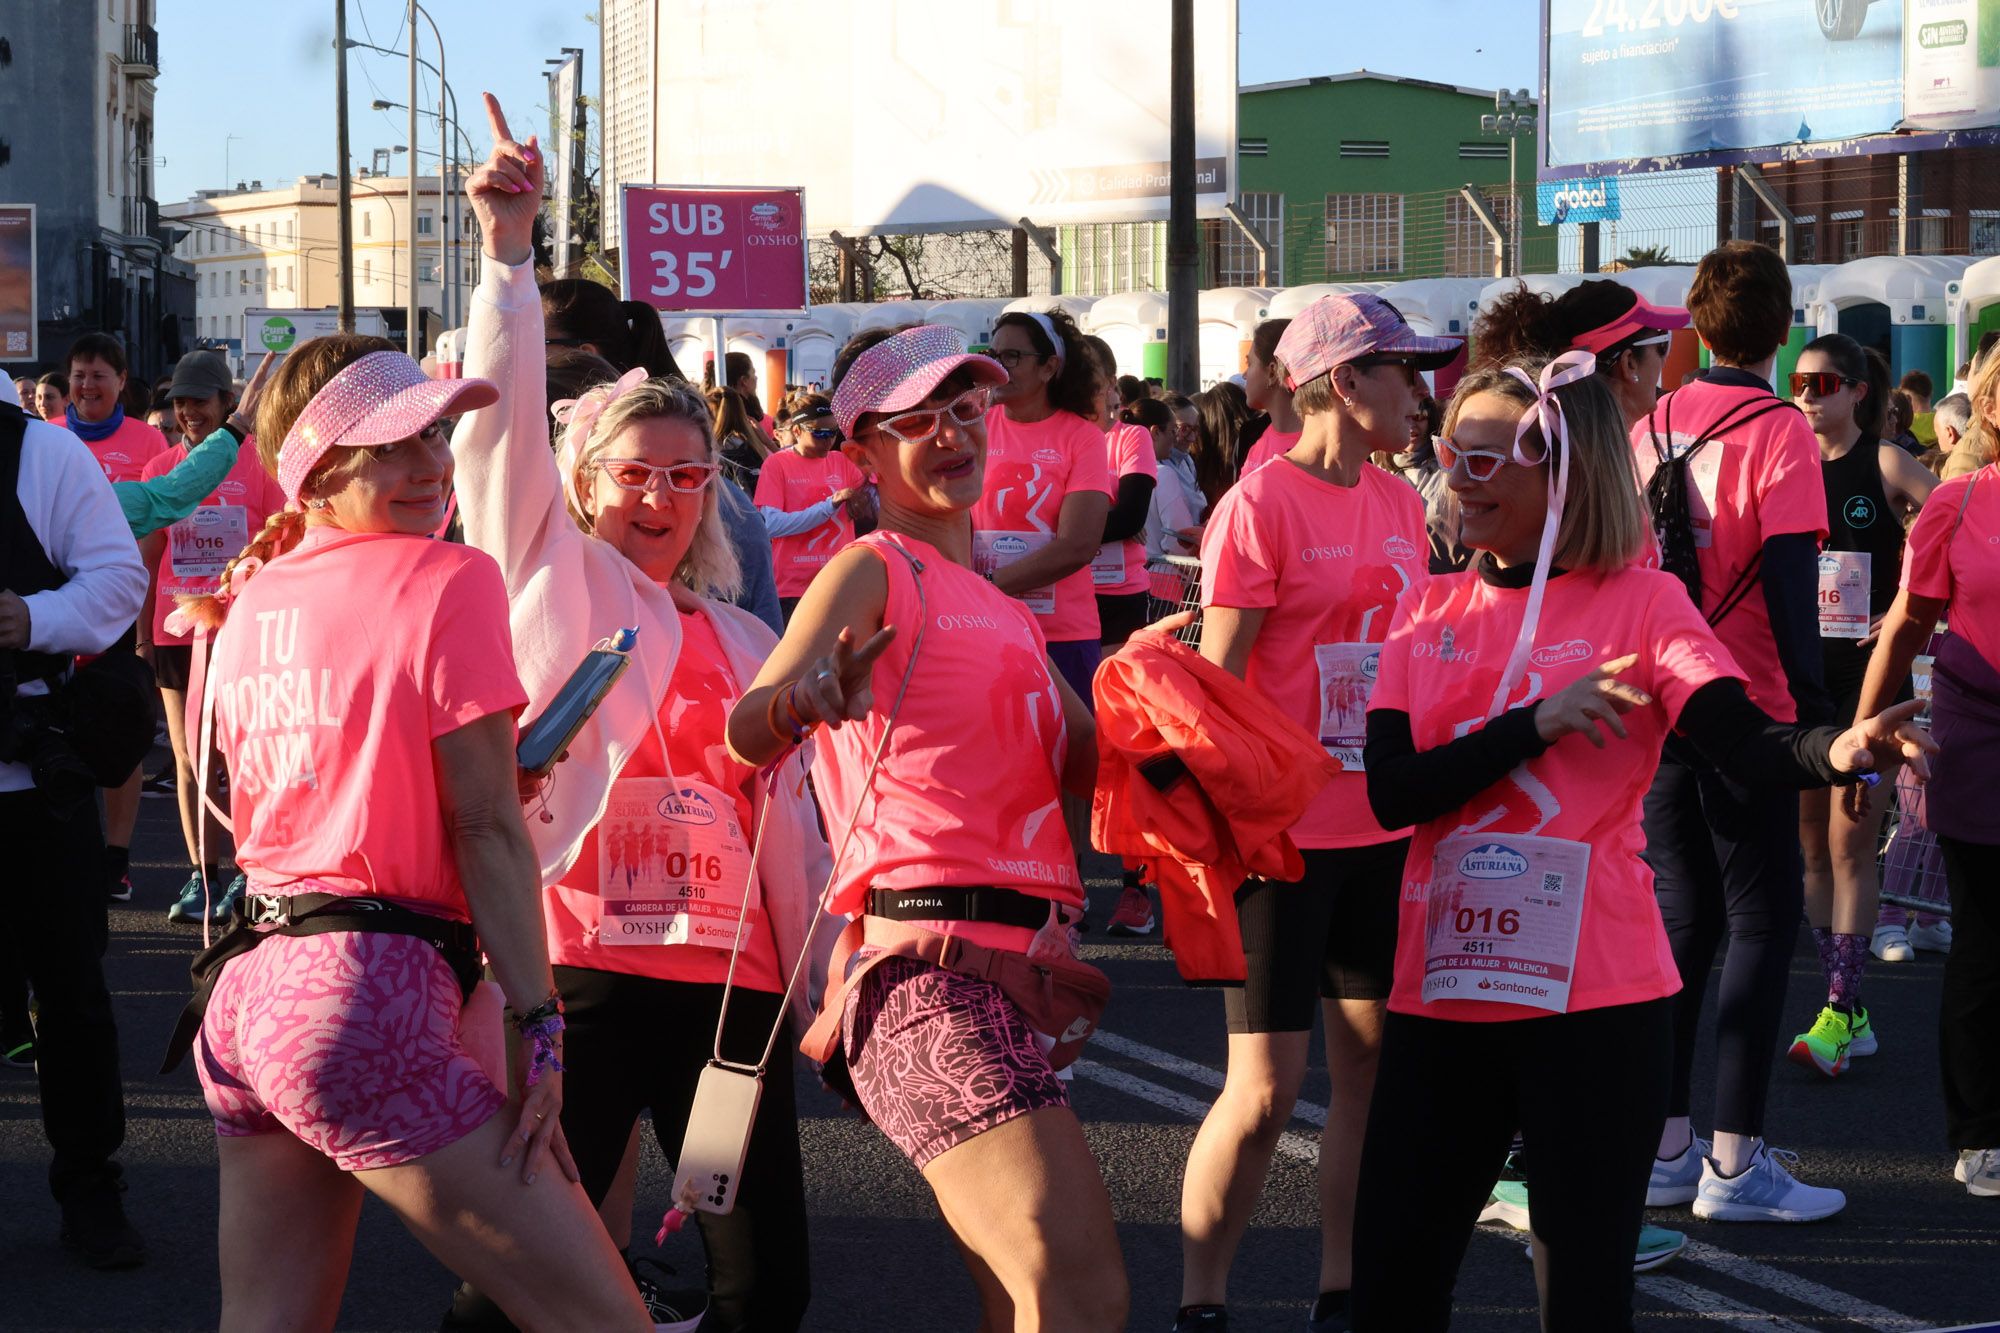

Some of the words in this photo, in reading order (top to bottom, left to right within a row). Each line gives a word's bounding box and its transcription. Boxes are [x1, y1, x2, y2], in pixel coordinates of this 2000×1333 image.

[1581, 50, 1610, 66] sujeto
[1612, 50, 1618, 60] a
[1100, 173, 1143, 192] Calidad
[1554, 180, 1607, 220] global
[648, 202, 725, 236] SUB
[747, 234, 799, 246] OYSHO
[263, 334, 282, 343] Car
[195, 537, 224, 549] 016
[995, 543, 1026, 551] ASTURIANA
[1302, 544, 1353, 562] OYSHO
[1818, 589, 1840, 604] 16
[937, 614, 998, 631] OYSHO
[255, 607, 300, 667] TU
[1412, 642, 1480, 665] OYHO
[1534, 647, 1588, 663] ASTURIANA
[1337, 738, 1363, 746] CARRERA
[614, 808, 650, 818] SUMA
[666, 852, 722, 882] 016
[987, 856, 1056, 883] CARRERA
[1057, 864, 1072, 886] DE
[1461, 857, 1522, 872] ASTURIANA
[678, 886, 706, 899] 4510
[625, 903, 663, 913] CARRERA
[666, 903, 676, 912] DE
[678, 903, 688, 912] LA
[689, 904, 711, 914] MUJER
[716, 907, 742, 919] VALENCI
[898, 898, 943, 909] APTONIA
[622, 921, 679, 935] OYSHO
[1455, 907, 1521, 935] 016
[1462, 941, 1493, 954] 4511
[1448, 958, 1459, 967] DE
[1460, 958, 1469, 967] LA
[1471, 958, 1500, 968] MUJER
[1508, 961, 1549, 975] VALENCIA
[1492, 980, 1549, 998] Santander
